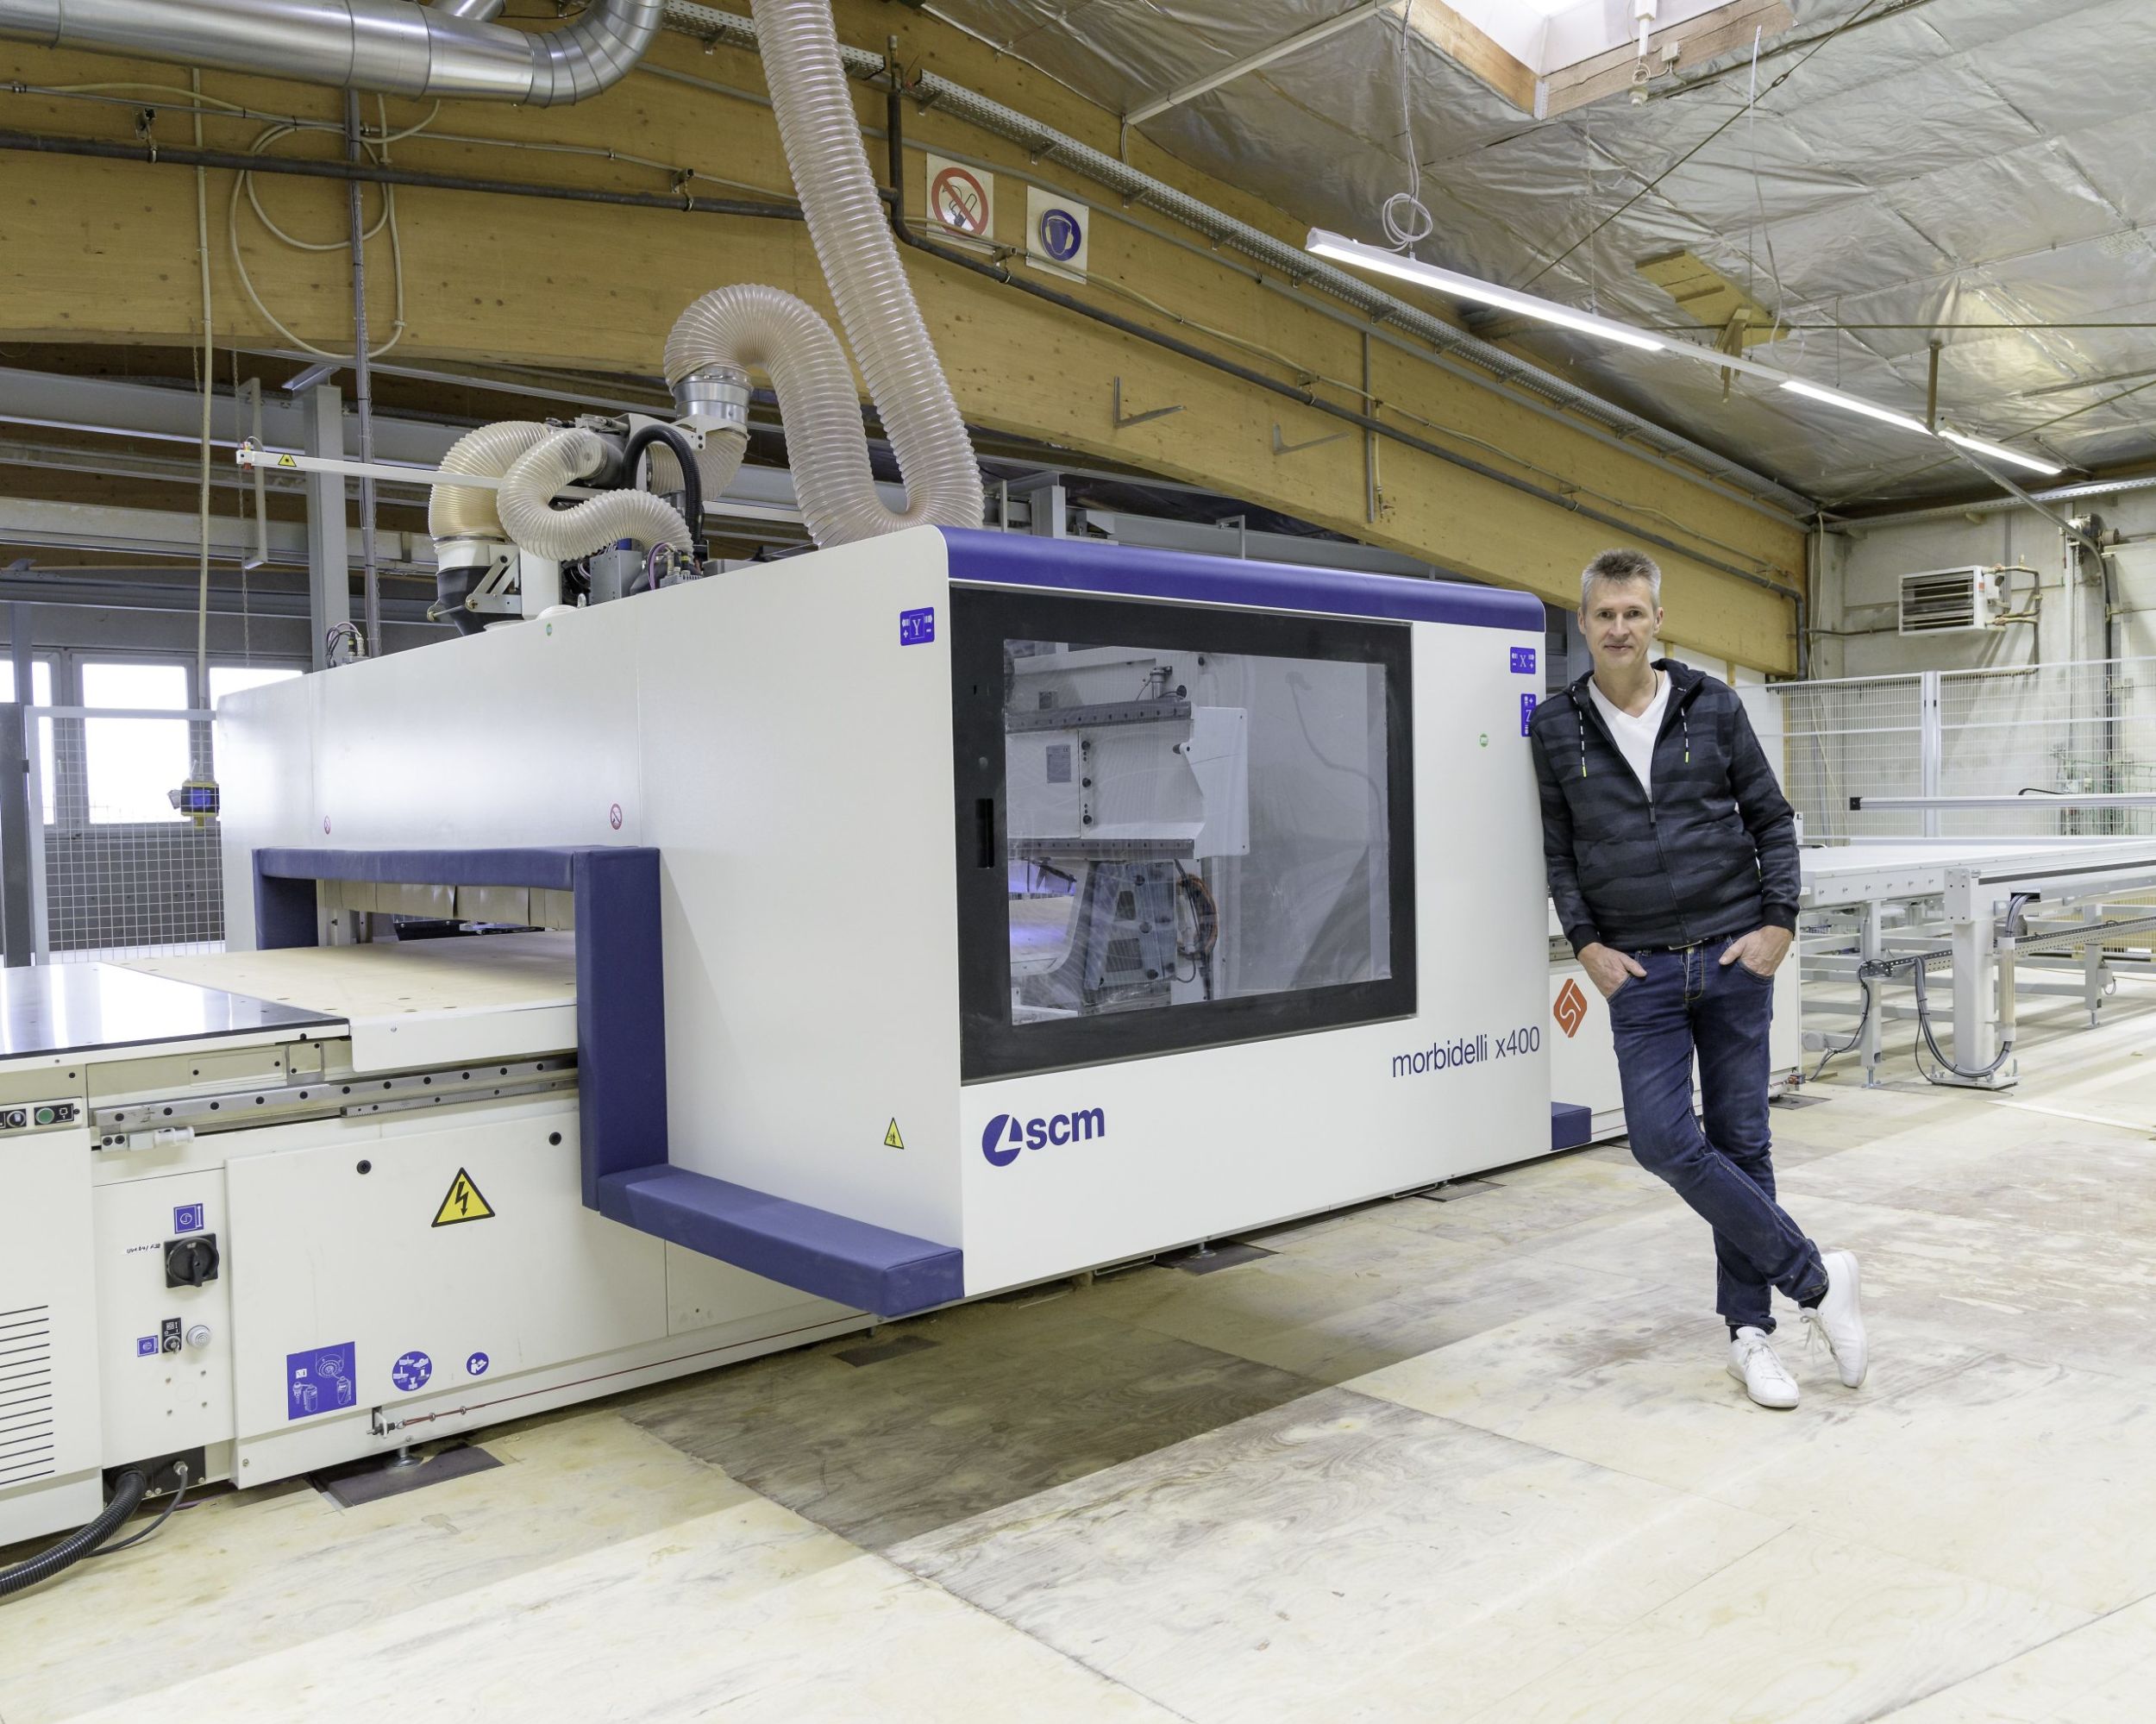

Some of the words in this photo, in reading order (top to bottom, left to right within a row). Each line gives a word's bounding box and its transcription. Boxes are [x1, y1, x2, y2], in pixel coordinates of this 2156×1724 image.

[912, 618, 921, 636] Y
[1520, 655, 1526, 668] X
[1392, 1034, 1488, 1077] morbidelli
[1495, 1026, 1540, 1059] x400
[1025, 1107, 1106, 1150] scm
